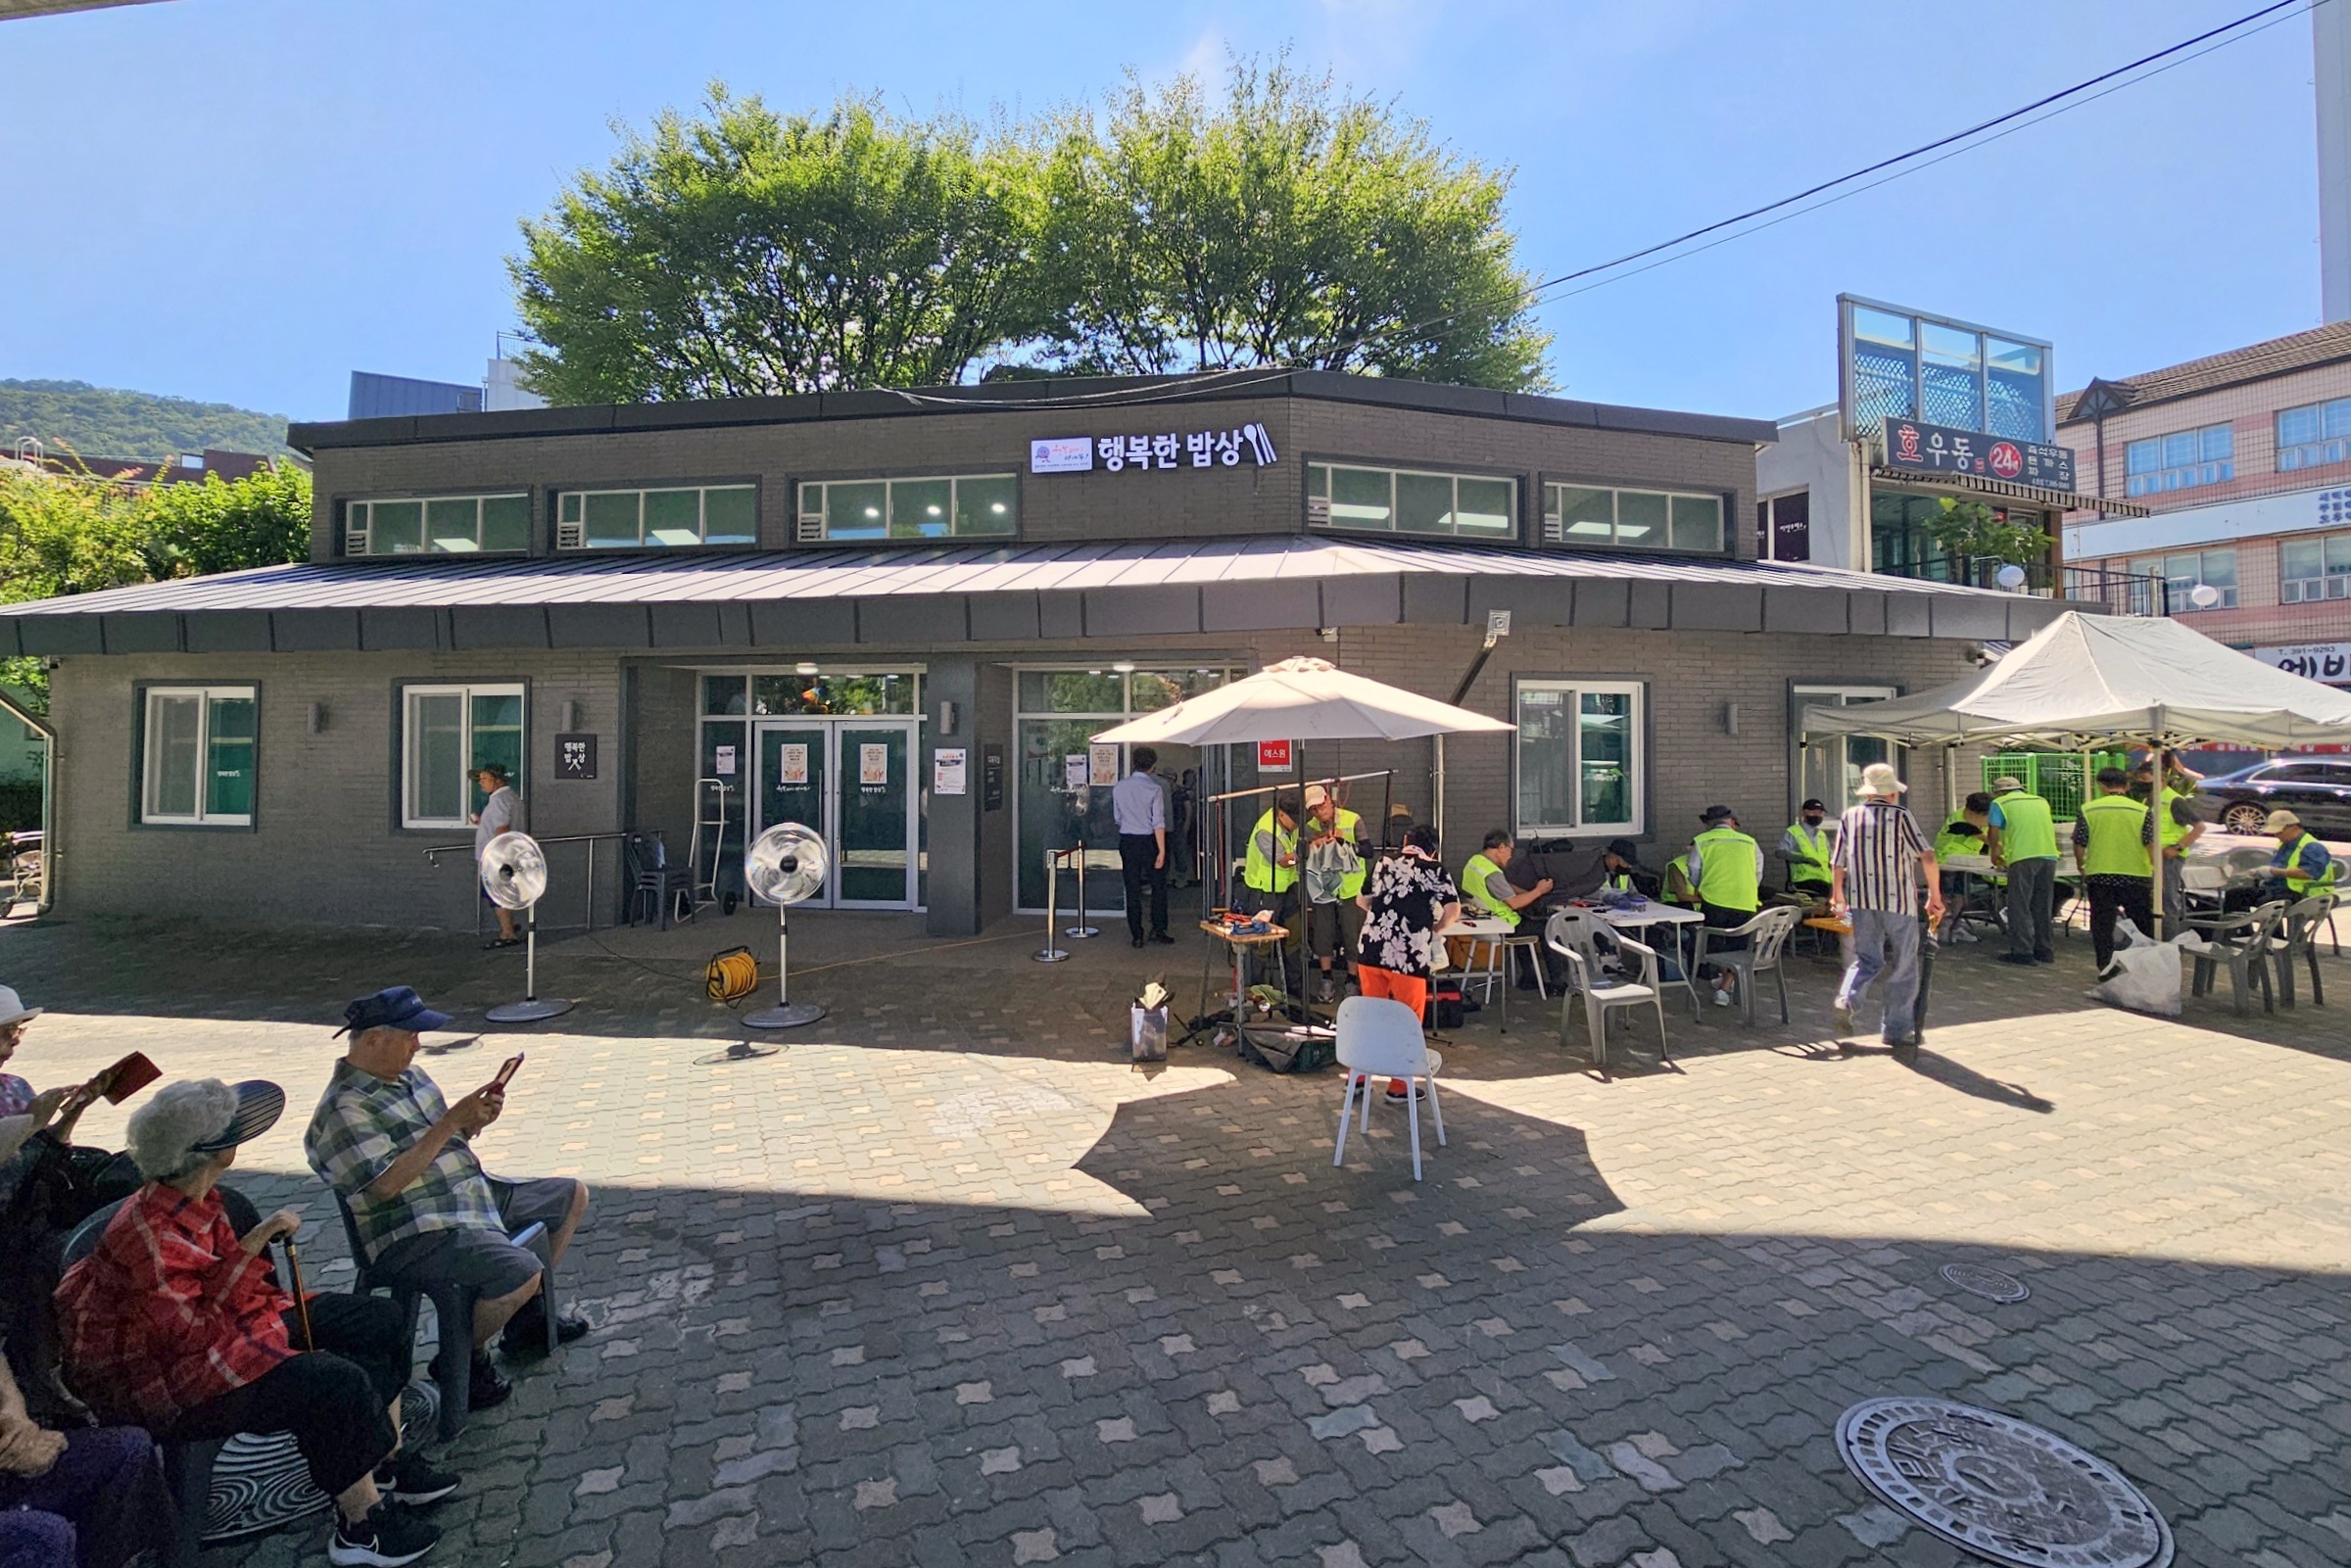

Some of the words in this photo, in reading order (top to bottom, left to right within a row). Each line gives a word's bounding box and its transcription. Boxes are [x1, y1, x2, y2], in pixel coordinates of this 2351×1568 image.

[1098, 433, 1180, 471] 행복한
[1187, 429, 1243, 468] 밥상
[1896, 424, 1974, 470] 호우동
[564, 752, 586, 763] 밥상
